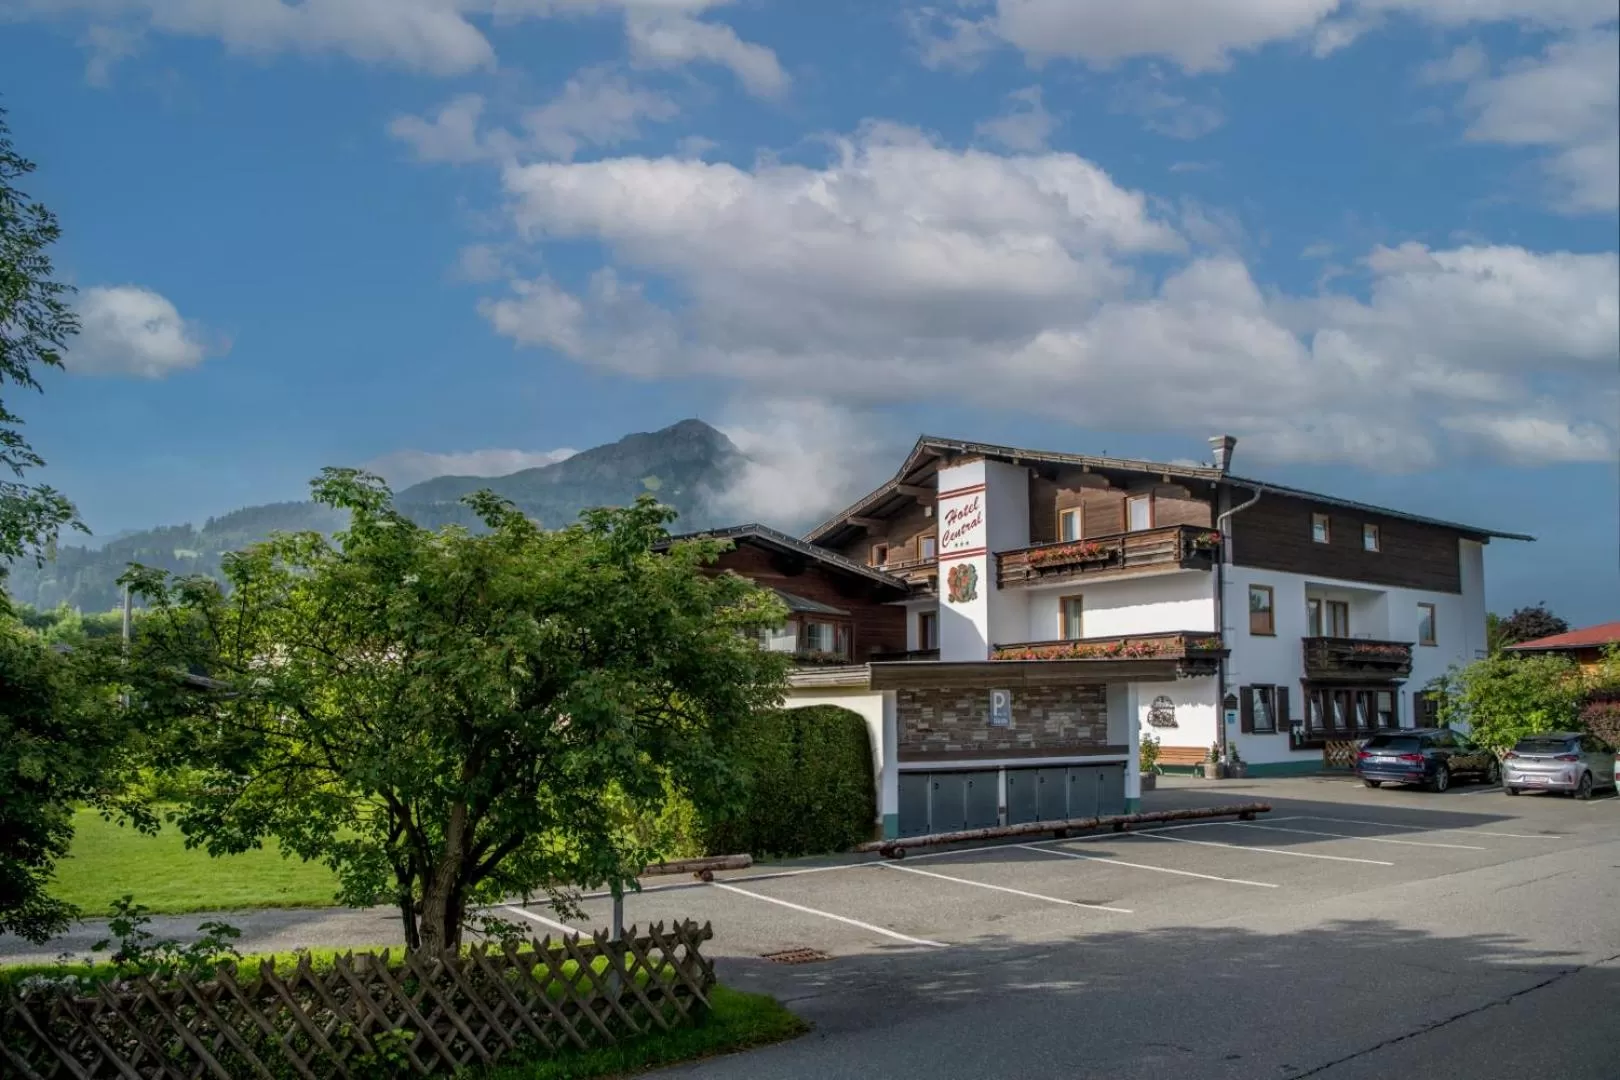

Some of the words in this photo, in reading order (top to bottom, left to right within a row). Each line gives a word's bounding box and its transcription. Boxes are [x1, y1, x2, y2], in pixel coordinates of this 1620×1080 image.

[945, 496, 980, 526] Hotel
[942, 511, 983, 548] Central
[993, 692, 1005, 716] P
